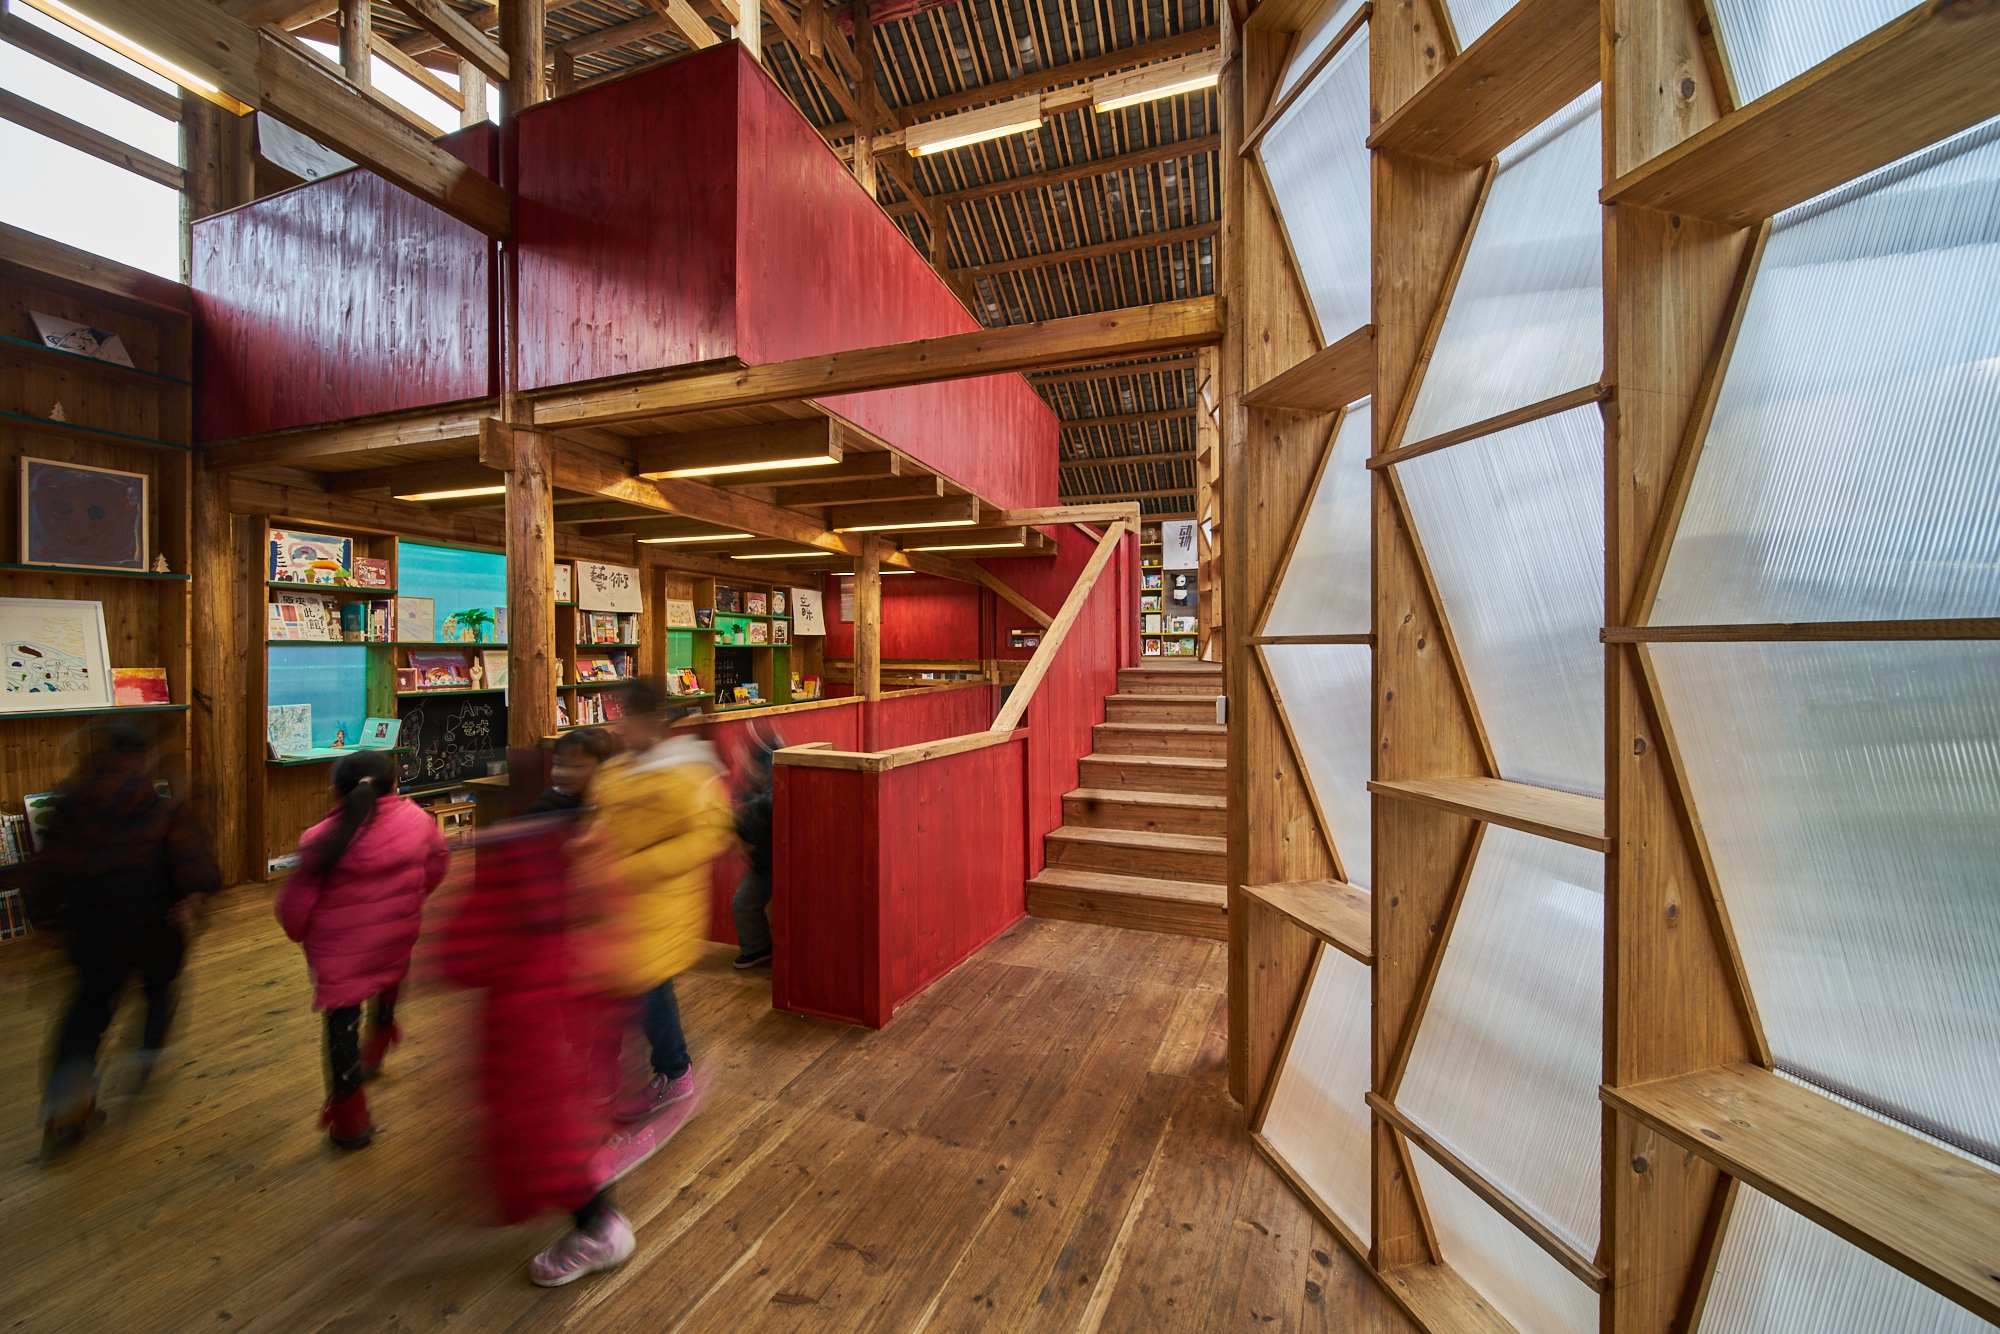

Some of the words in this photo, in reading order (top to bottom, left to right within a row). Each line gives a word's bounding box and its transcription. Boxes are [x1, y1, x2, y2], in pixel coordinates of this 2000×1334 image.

[1179, 524, 1193, 552] 动物
[589, 565, 629, 593] 藝術
[459, 699, 494, 719] Art
[461, 719, 490, 737] 艺术
